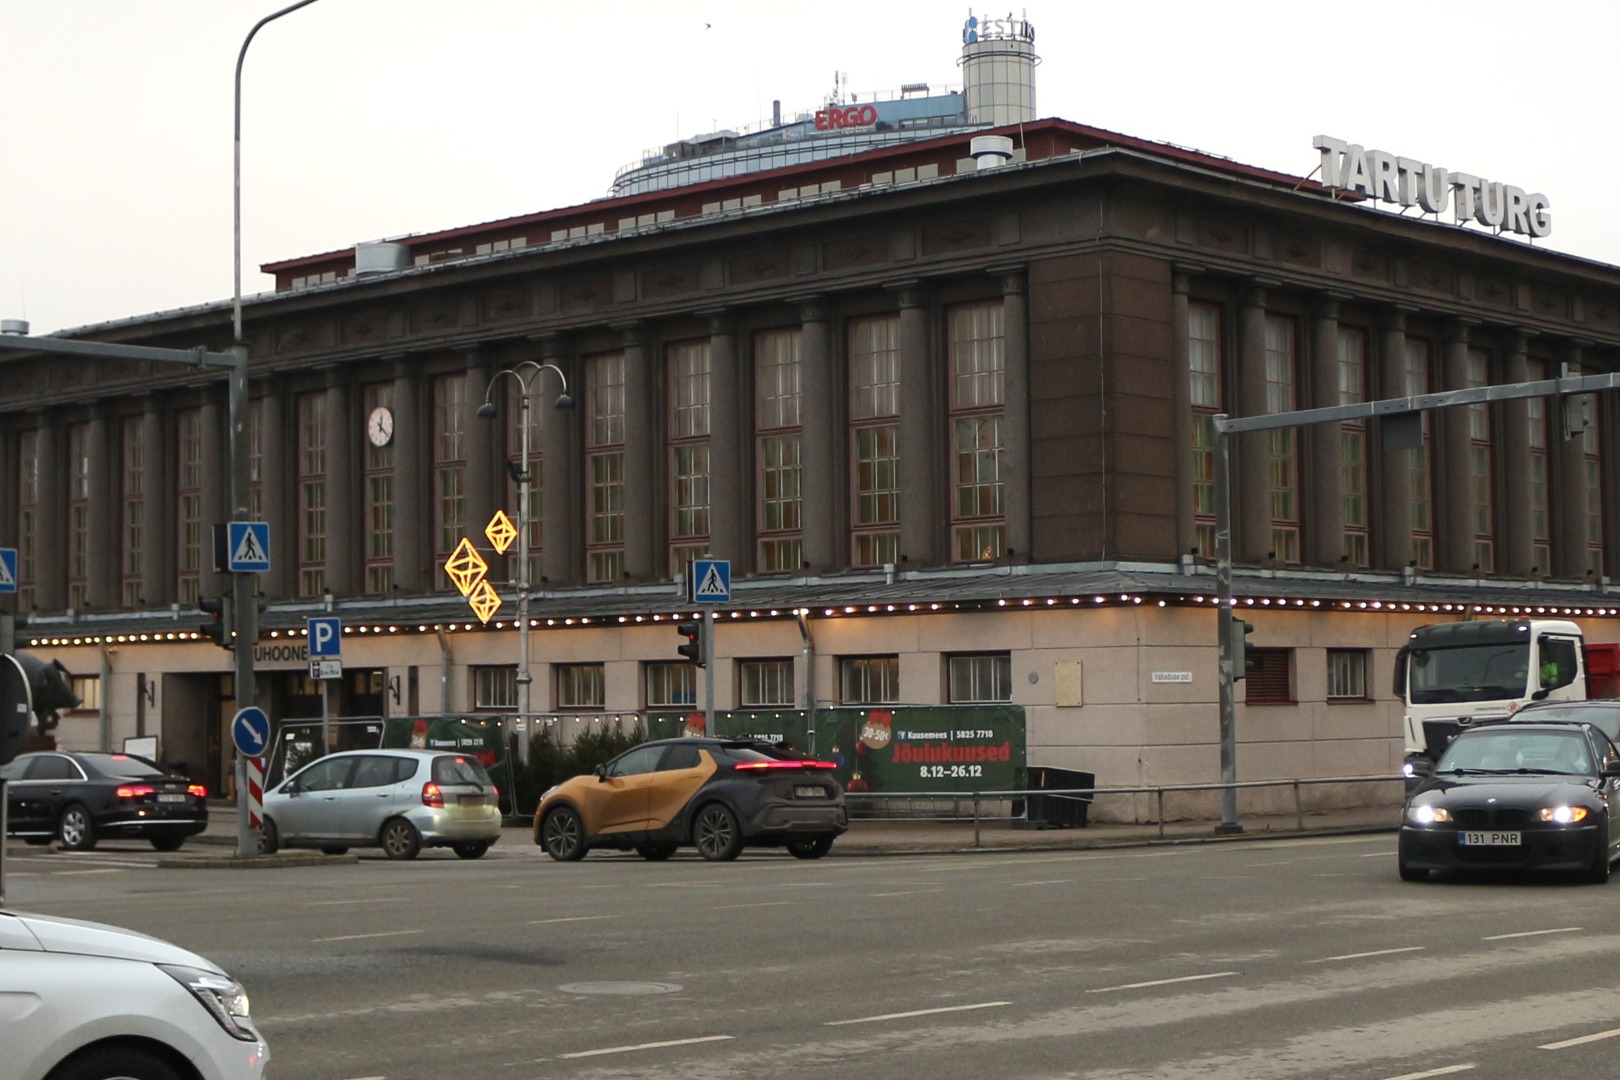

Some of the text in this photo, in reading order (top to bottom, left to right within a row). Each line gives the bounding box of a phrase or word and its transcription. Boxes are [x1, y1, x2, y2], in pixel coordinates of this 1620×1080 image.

[815, 104, 877, 130] ERGO
[1313, 135, 1552, 238] TARTU TURG
[315, 622, 333, 652] P
[907, 731, 948, 740] Kuusemees
[956, 730, 975, 739] 5825
[976, 730, 994, 738] 7710
[892, 741, 1011, 763] Jõulukuused
[1467, 833, 1519, 844] 131 PNR
